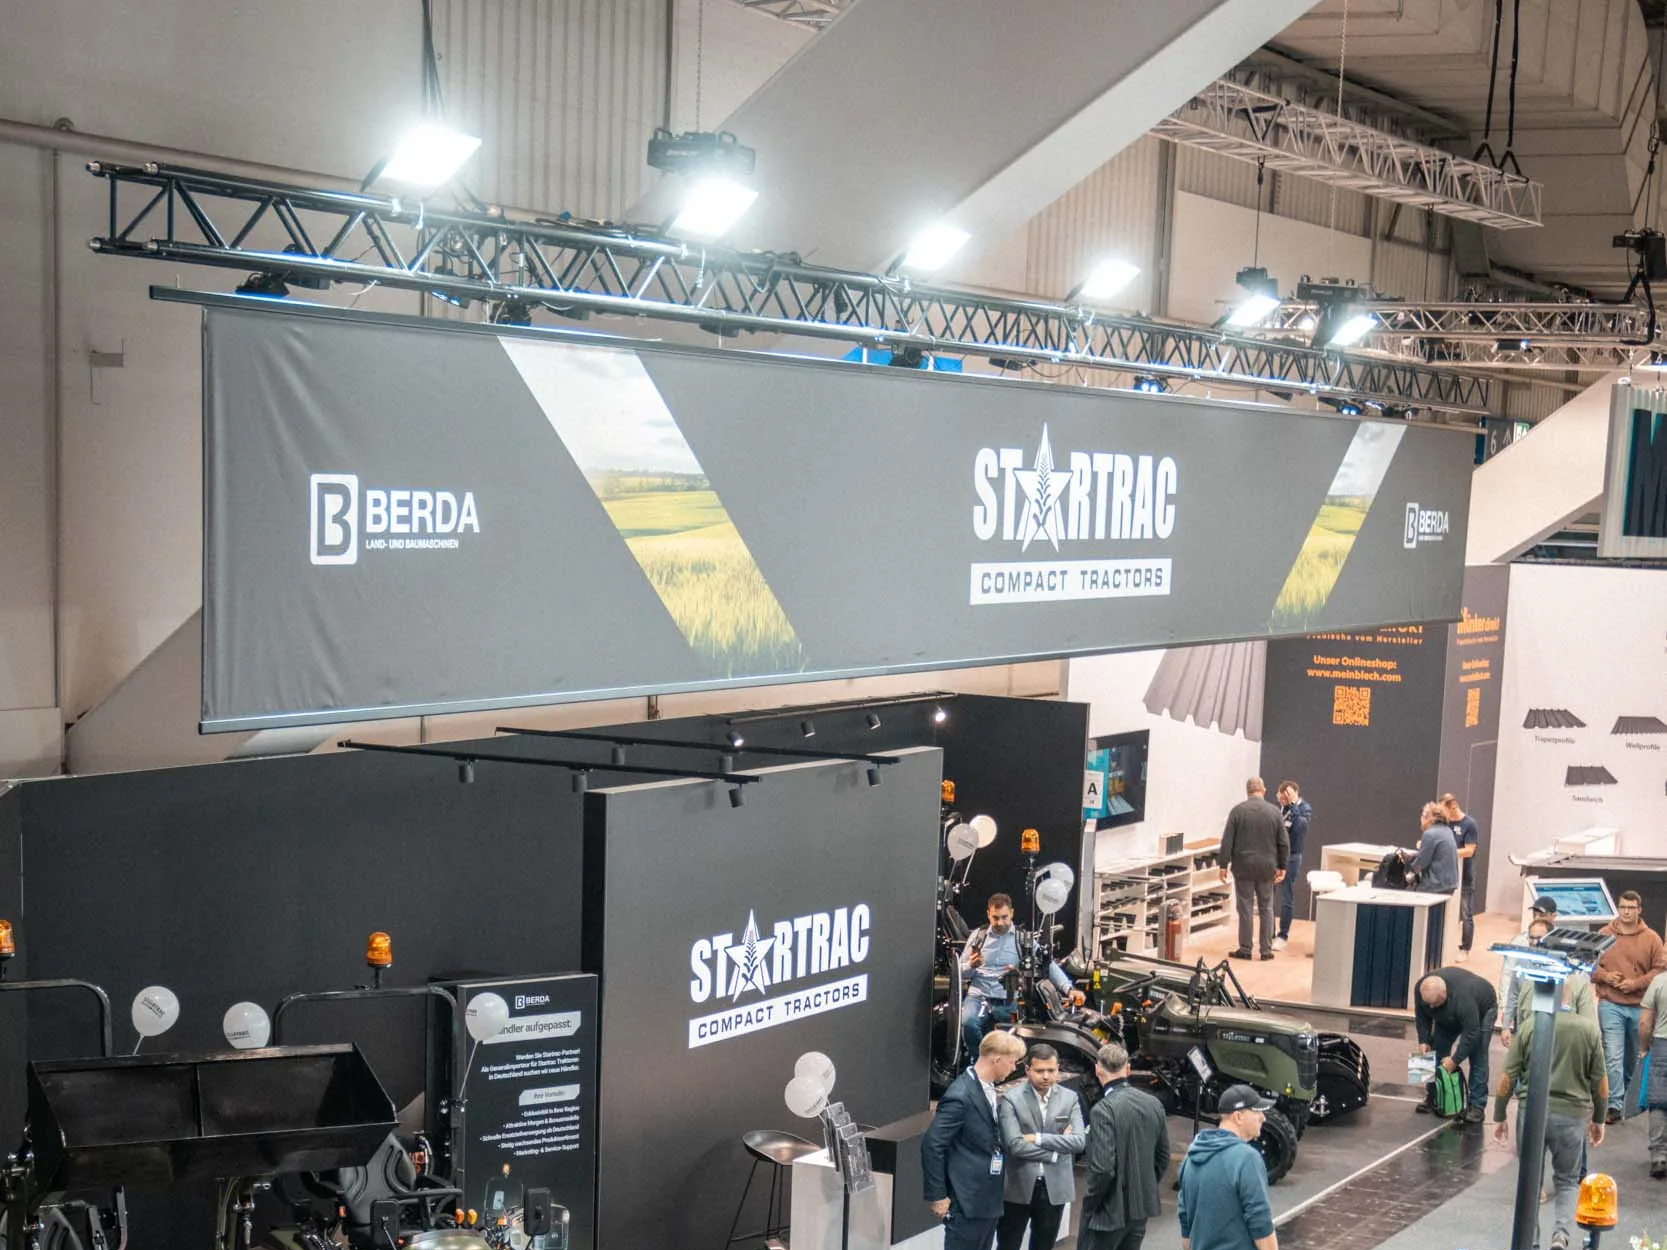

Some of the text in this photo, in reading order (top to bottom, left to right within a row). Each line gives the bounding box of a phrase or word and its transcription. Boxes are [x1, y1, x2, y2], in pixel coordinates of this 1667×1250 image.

[1490, 430, 1497, 455] 6
[365, 489, 481, 534] BERDA
[1418, 509, 1449, 534] BERDA
[365, 538, 459, 550] LAND- UND BAUMASCHINEN
[980, 567, 1164, 595] COMPACT TRACTORS
[1306, 667, 1402, 682] www.meinblech.com
[1313, 654, 1398, 670] Unser Onlineshop:
[1087, 782, 1098, 796] A
[690, 904, 871, 1004] STARTRAC
[525, 996, 550, 1005] BERDA
[697, 982, 861, 1039] COMPACT TRACTORS
